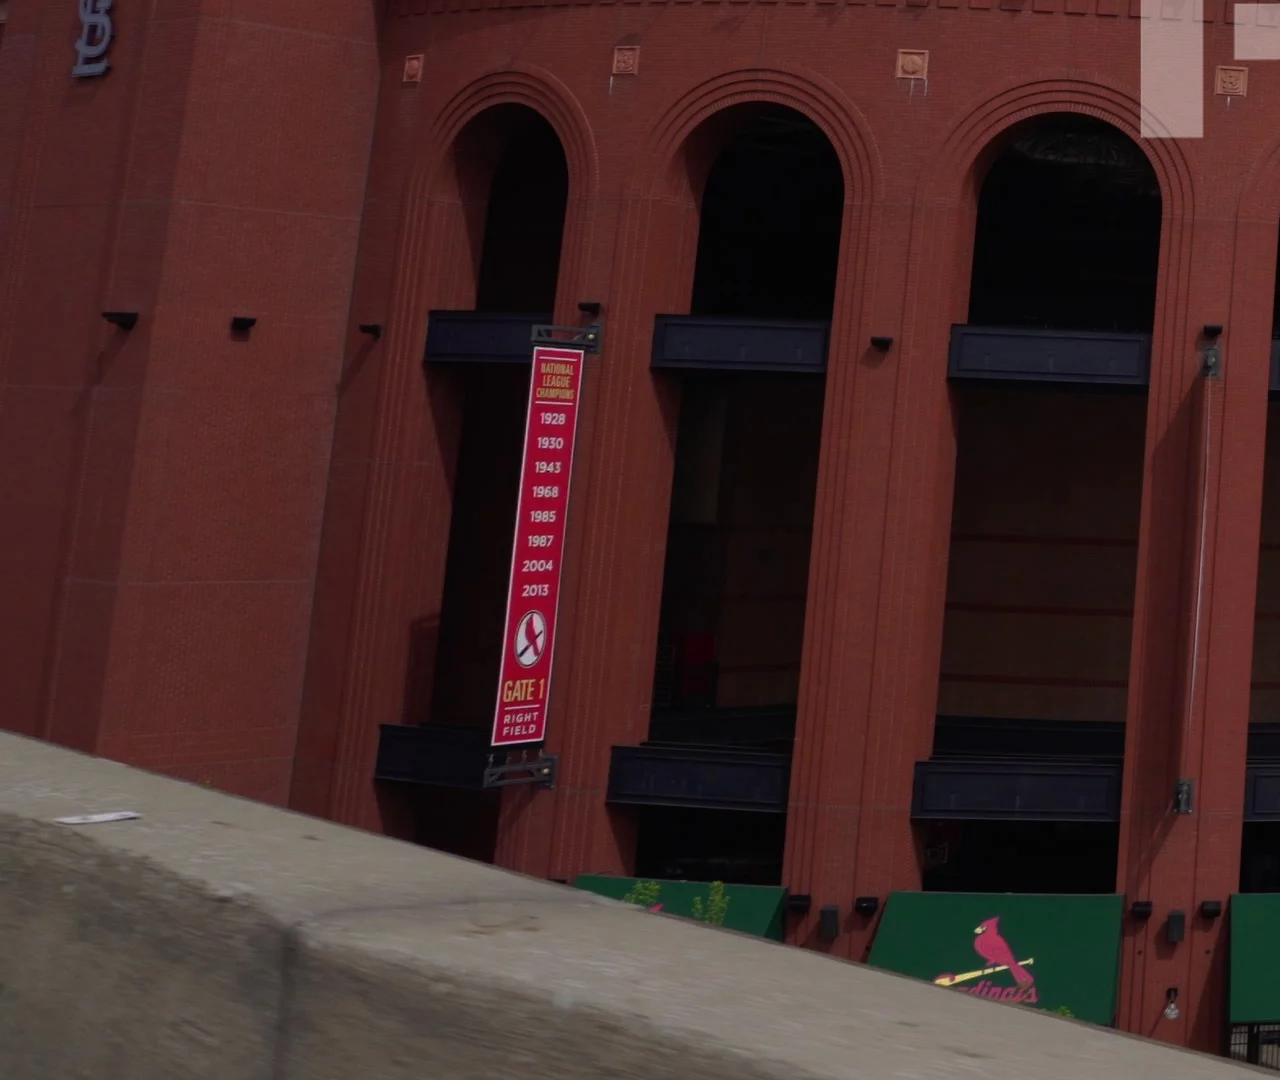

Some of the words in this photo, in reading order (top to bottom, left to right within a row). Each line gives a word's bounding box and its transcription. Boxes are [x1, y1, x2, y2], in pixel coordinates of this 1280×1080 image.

[540, 362, 574, 375] NATIONAL
[542, 375, 571, 388] LEAGUE
[535, 387, 575, 400] CHAMPIONS
[540, 412, 566, 425] 1928
[537, 436, 564, 449] 1930
[535, 461, 562, 474] 1943
[532, 485, 559, 498] 1968
[530, 510, 556, 523] 1985
[527, 535, 554, 548] 1987
[521, 559, 553, 573] 2004
[521, 584, 549, 597] 2013
[502, 678, 536, 703] GATE
[538, 677, 545, 700] 1
[503, 711, 539, 724] RIGHT
[502, 724, 537, 737] FIELD
